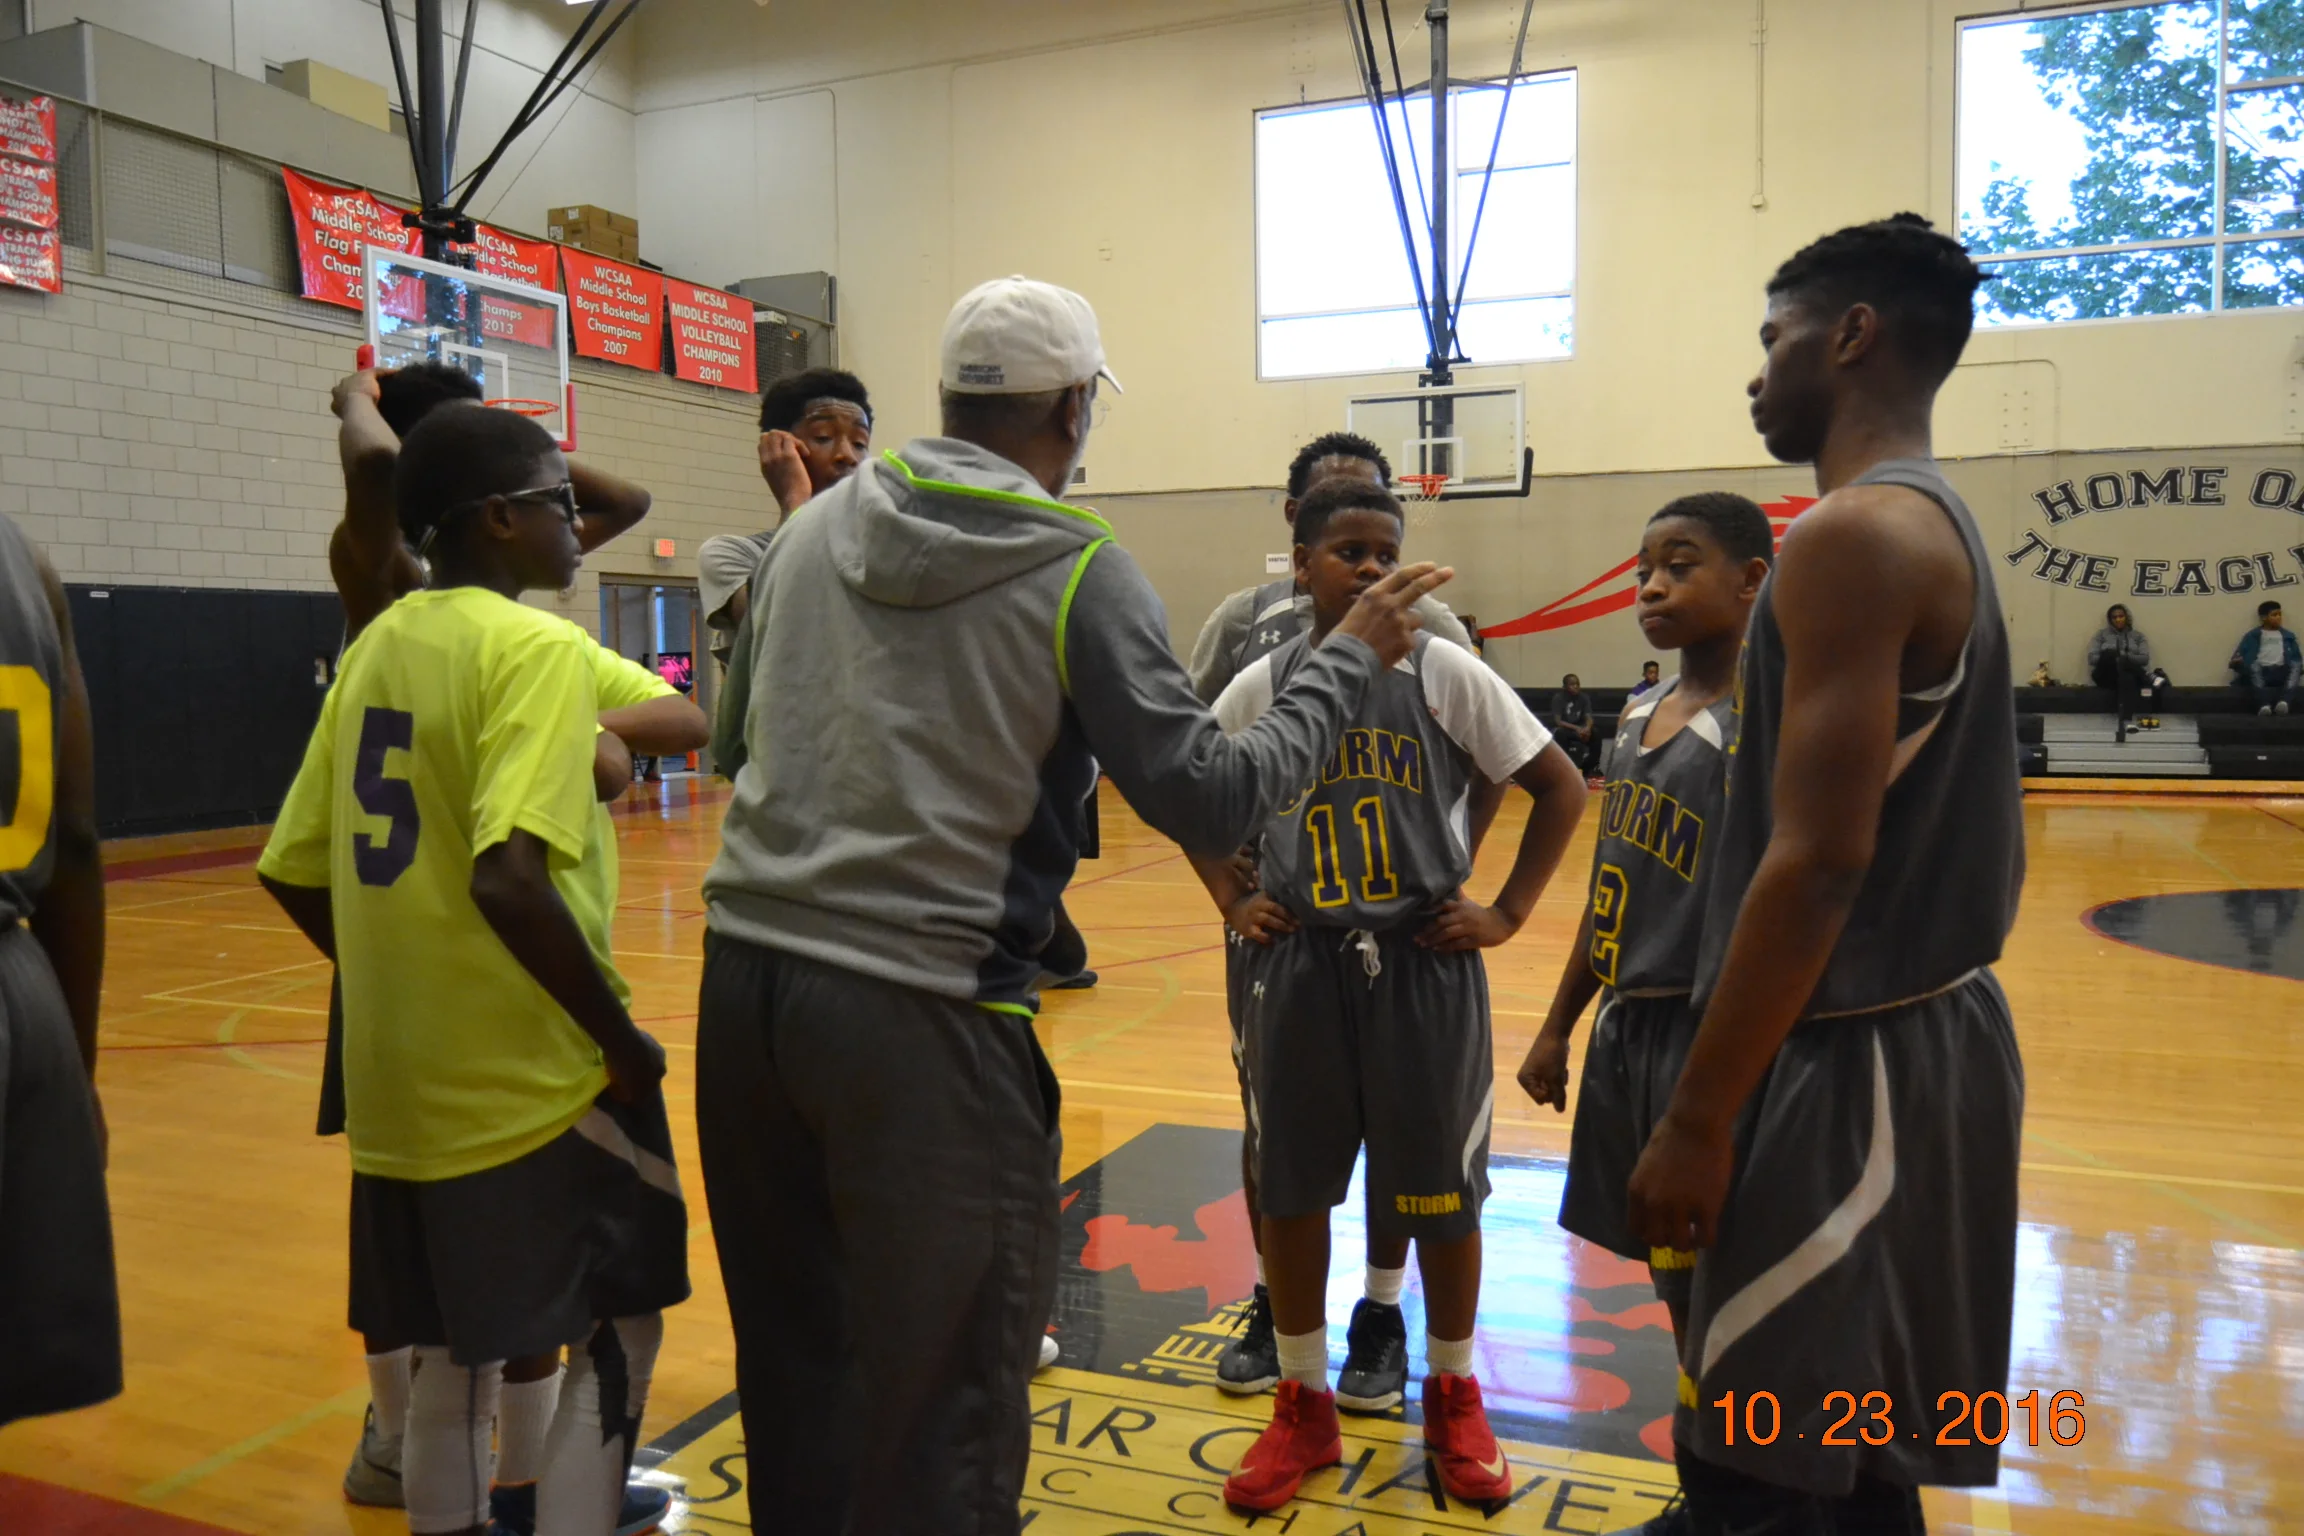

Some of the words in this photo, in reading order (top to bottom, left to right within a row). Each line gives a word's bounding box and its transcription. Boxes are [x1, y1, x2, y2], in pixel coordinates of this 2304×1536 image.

[334, 195, 381, 222] PCSAA
[1, 228, 53, 248] CSAA
[312, 207, 363, 233] Middle
[366, 221, 409, 245] School
[315, 230, 349, 255] Flag
[500, 256, 538, 275] School
[594, 265, 633, 287] WCSAA
[580, 277, 614, 298] Middle
[616, 287, 647, 306] School
[693, 288, 728, 311] WCSAA
[576, 296, 600, 315] Boys
[602, 302, 650, 325] Basketball
[672, 302, 709, 325] MIDDLE
[712, 312, 748, 334] SCHOOL
[484, 318, 514, 335] 2013
[587, 316, 642, 341] Champions
[681, 324, 742, 350] VOLLEYBALL
[603, 340, 628, 356] 2007
[683, 344, 741, 368] CHAMPIONS
[699, 366, 723, 382] 2010
[2031, 465, 2228, 527] HOME
[2004, 528, 2119, 593] THE
[353, 706, 421, 888] 5
[1306, 796, 1398, 909] 11
[1395, 1191, 1462, 1216] STORM
[1187, 1425, 1685, 1534] CHAVE
